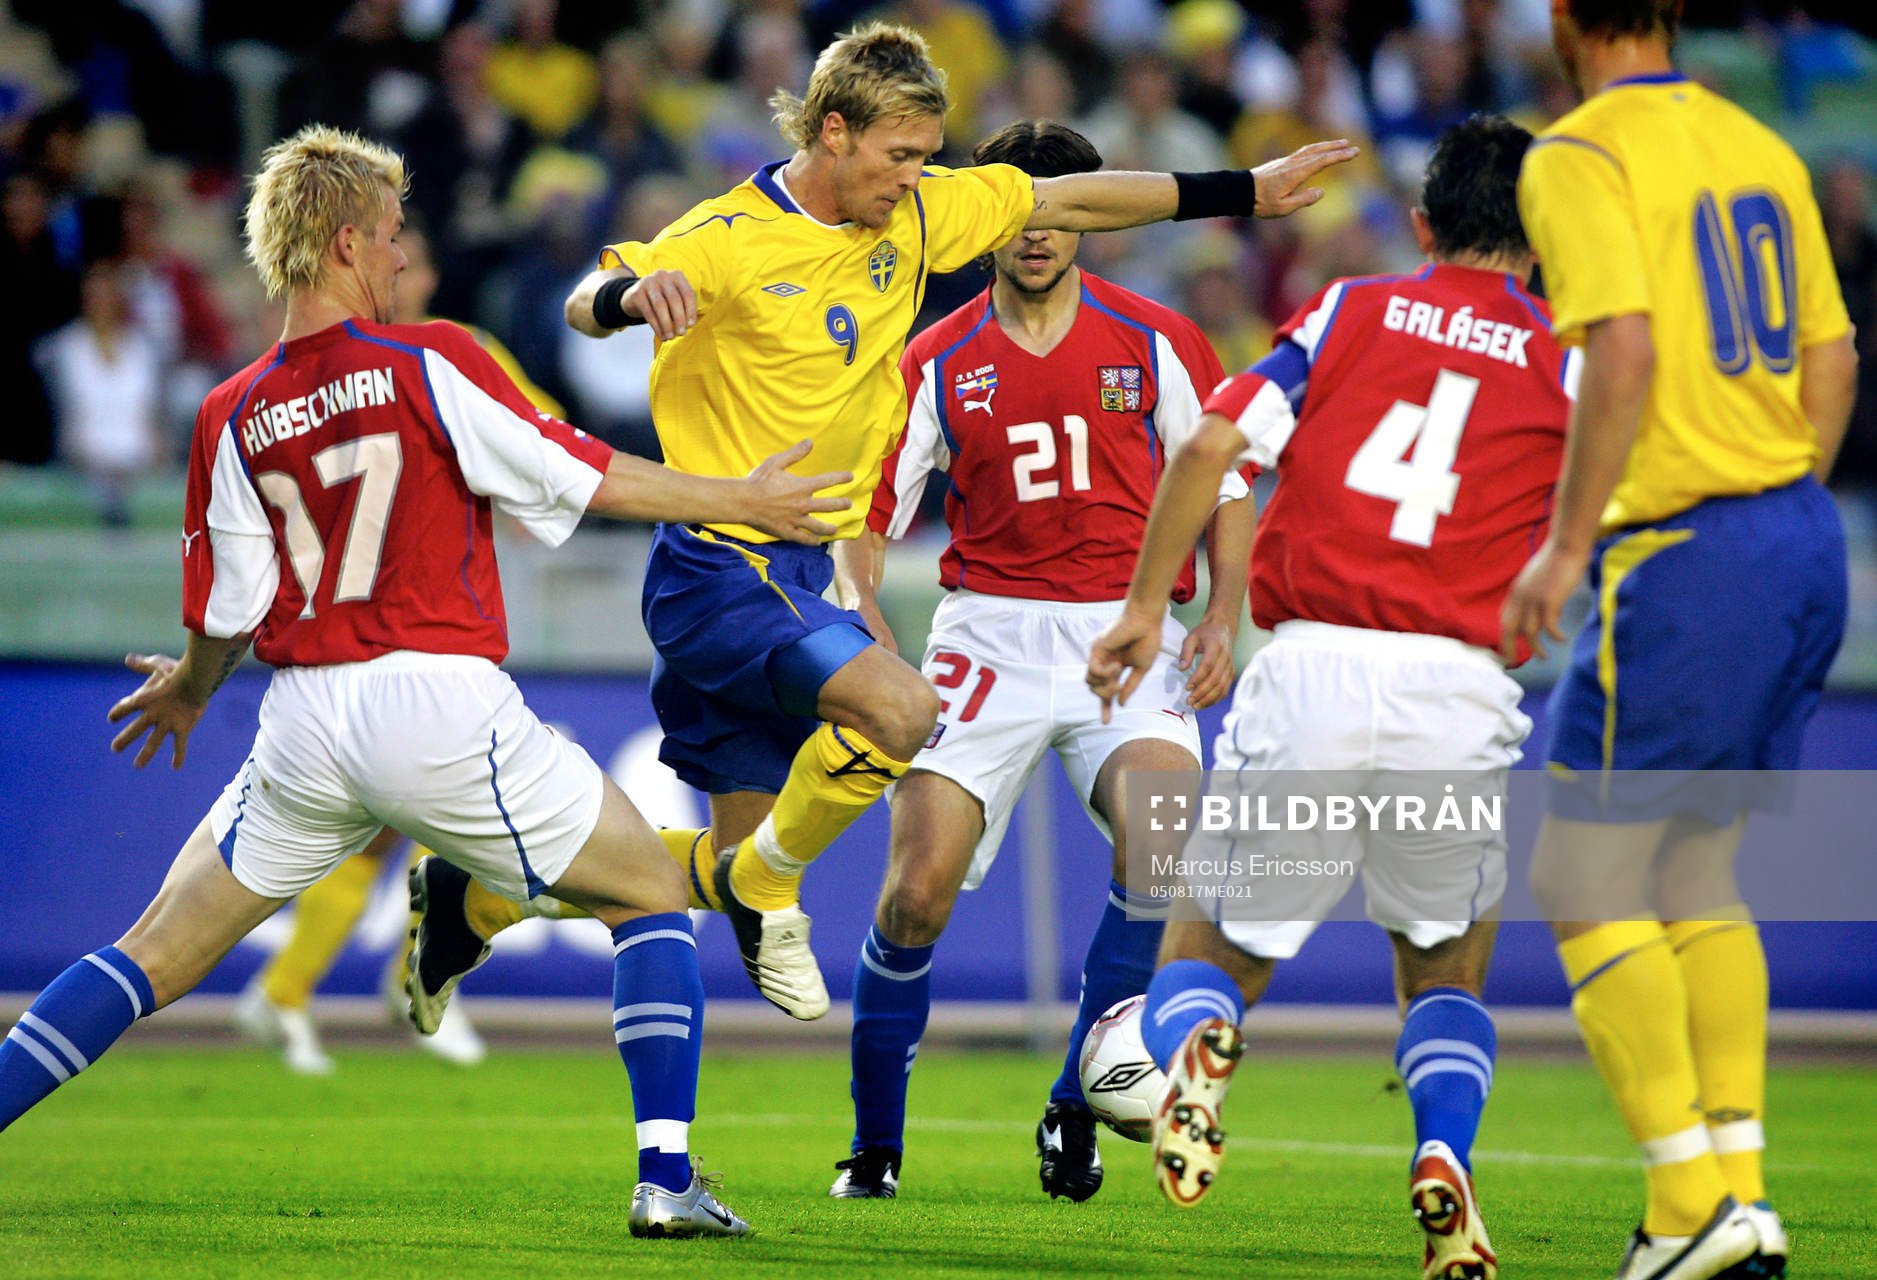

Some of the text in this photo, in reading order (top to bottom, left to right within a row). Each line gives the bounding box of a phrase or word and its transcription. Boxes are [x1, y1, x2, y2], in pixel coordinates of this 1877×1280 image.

[1692, 187, 1798, 377] 10
[824, 303, 859, 367] 9
[1383, 295, 1533, 368] GALÁSEK
[243, 367, 396, 456] HÜBSCHMAN
[1006, 414, 1092, 503] 21
[1344, 368, 1480, 548] 4
[255, 431, 404, 620] 17
[932, 651, 997, 723] 21
